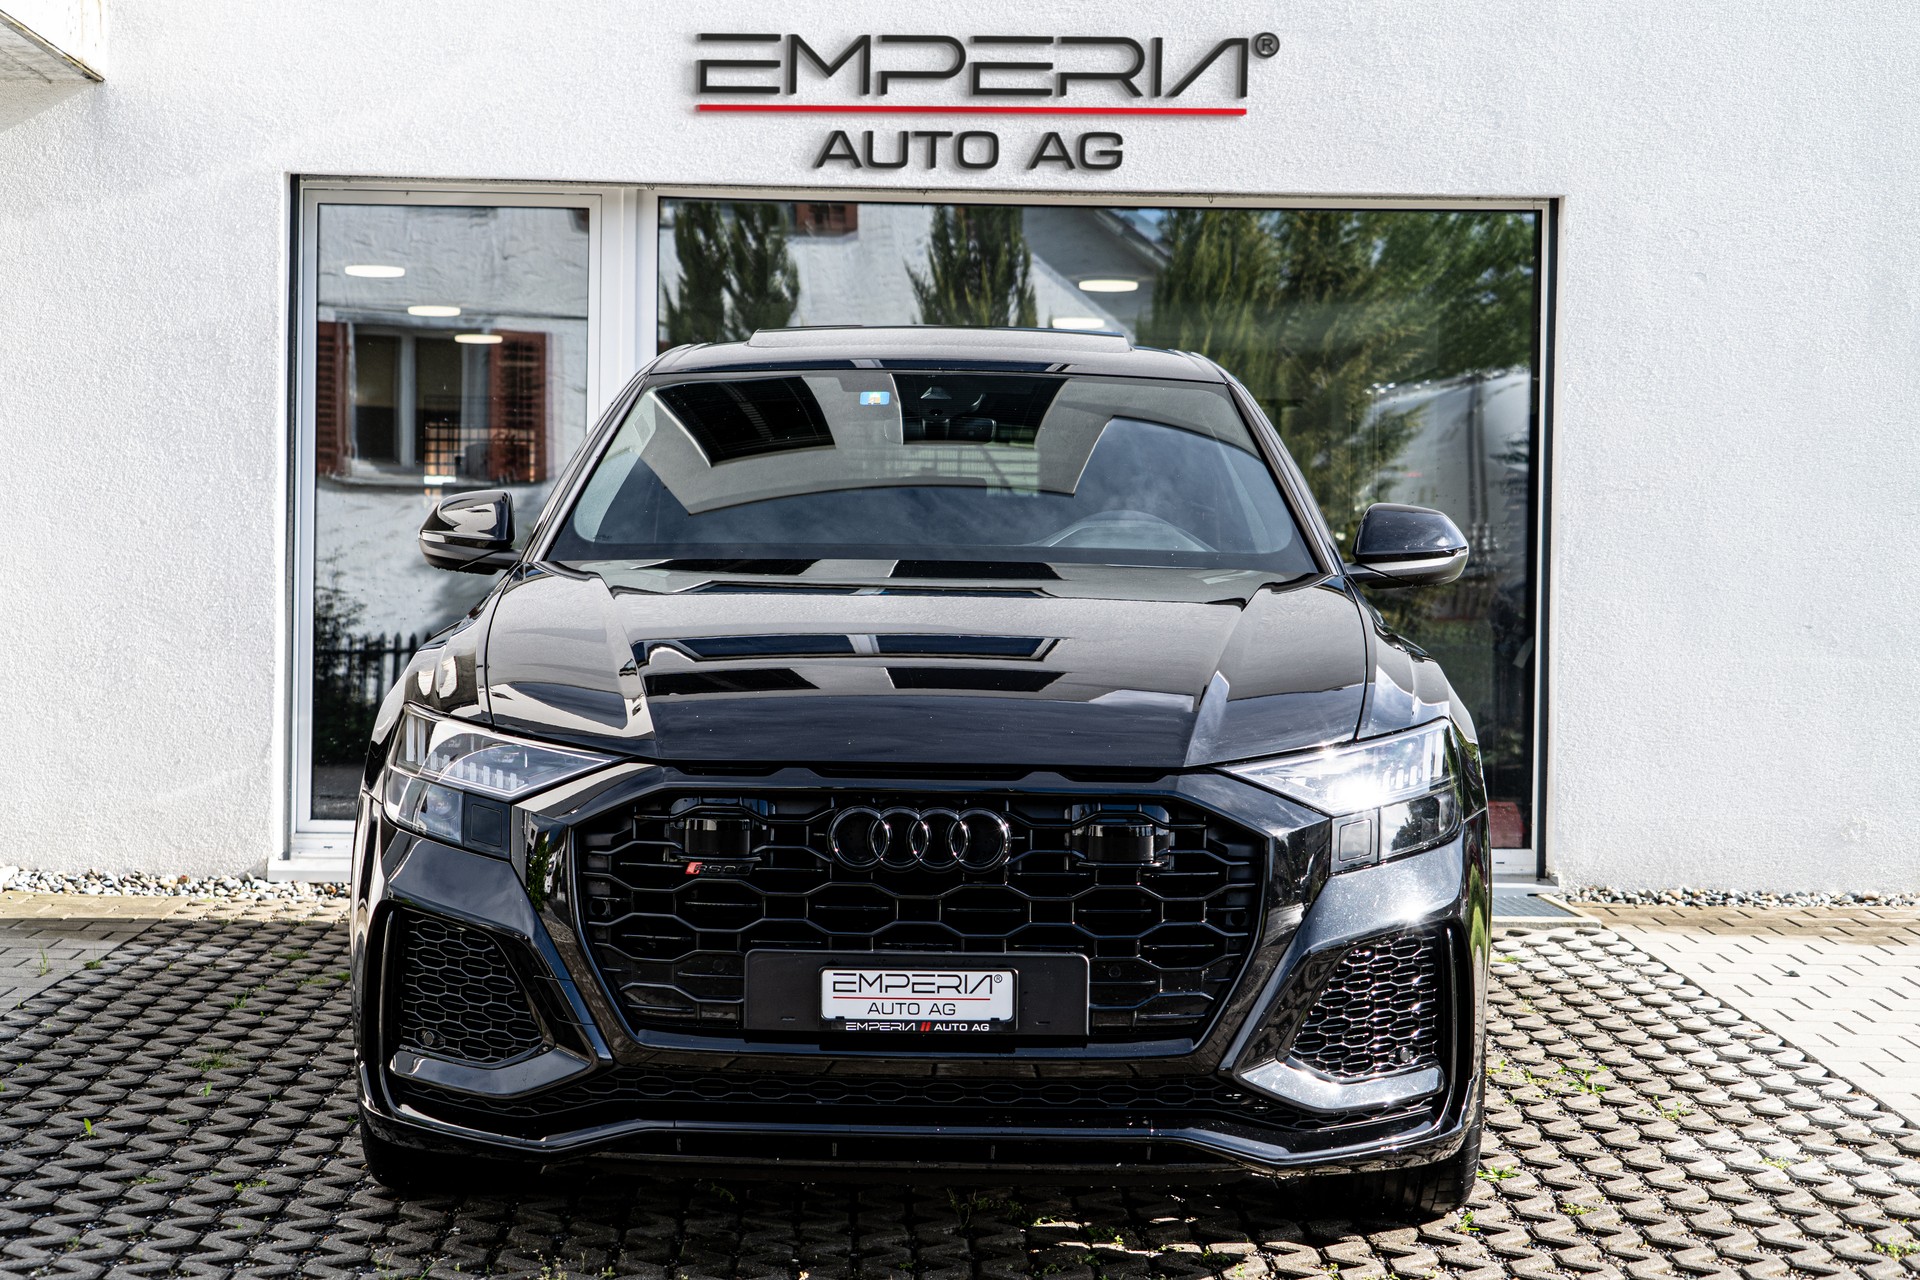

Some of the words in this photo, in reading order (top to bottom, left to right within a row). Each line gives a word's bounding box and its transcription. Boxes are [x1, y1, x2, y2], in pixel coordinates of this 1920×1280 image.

[815, 130, 1000, 170] AUTO
[1029, 131, 1124, 171] AG
[867, 1002, 921, 1016] AUTO
[928, 1003, 956, 1016] AG
[845, 1022, 916, 1032] EMPERIA
[934, 1023, 968, 1032] AUTO
[971, 1023, 990, 1032] AG
